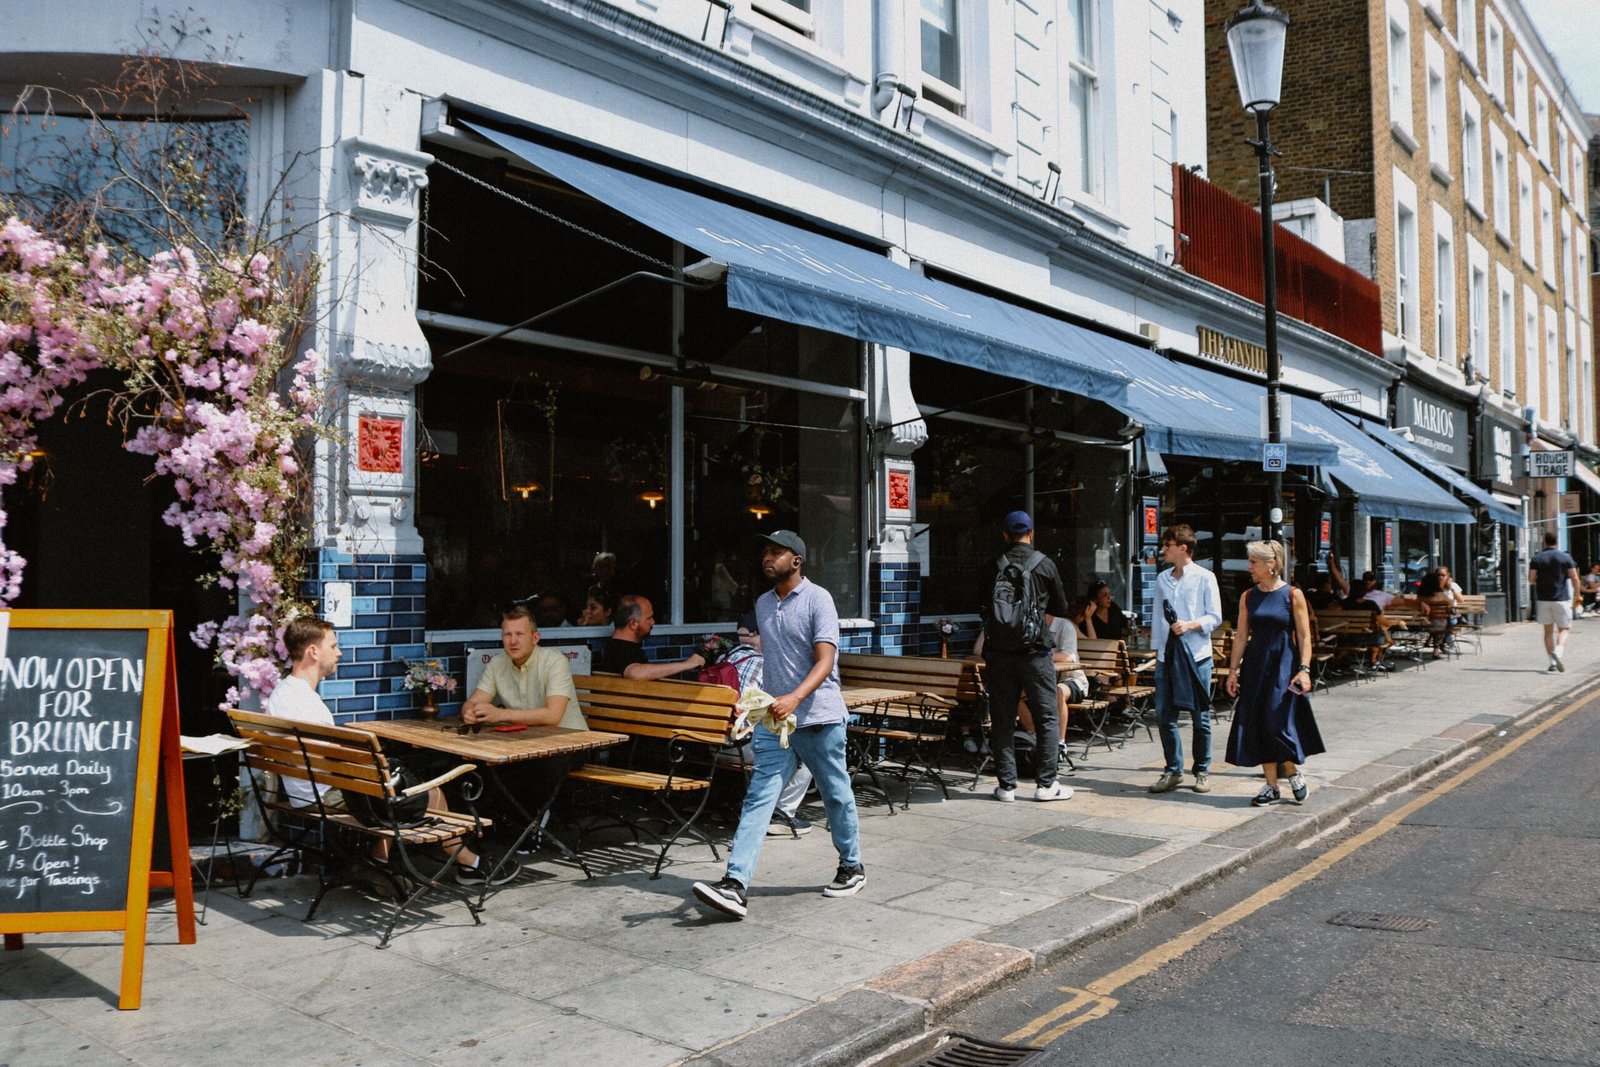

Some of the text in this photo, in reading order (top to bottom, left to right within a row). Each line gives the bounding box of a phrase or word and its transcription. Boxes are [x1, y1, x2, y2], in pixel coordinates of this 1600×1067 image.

[1198, 326, 1225, 359] THE
[1412, 397, 1454, 439] MARIOS
[1535, 452, 1569, 464] ROUGH
[1536, 464, 1569, 476] TRADE
[1, 655, 144, 694] NOW OPEN
[38, 690, 92, 718] FOR
[10, 720, 133, 756] BRUNCH
[0, 759, 112, 784] Served Daily
[2, 783, 45, 799] 10am
[59, 780, 90, 797] 3pm
[17, 824, 108, 851] Bottle Shop
[16, 875, 41, 899] for
[45, 872, 100, 894] Tastings
